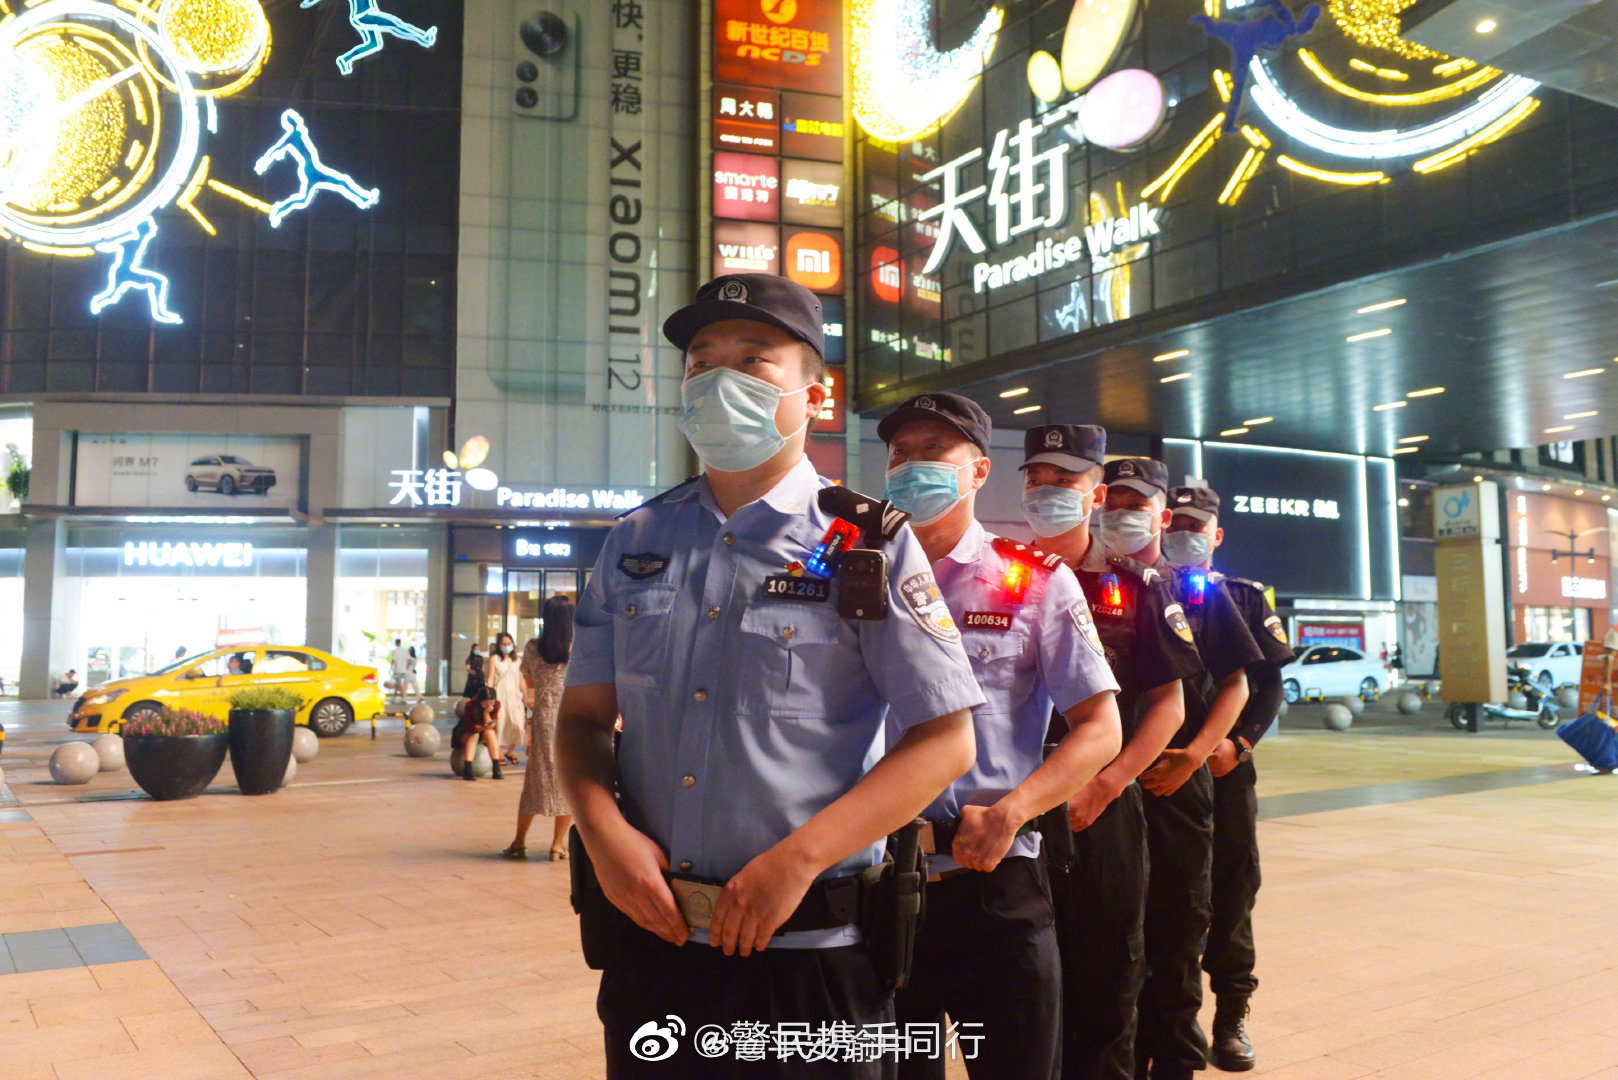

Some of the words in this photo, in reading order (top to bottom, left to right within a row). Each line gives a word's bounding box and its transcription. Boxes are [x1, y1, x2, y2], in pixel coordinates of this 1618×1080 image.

[726, 19, 831, 54] 新世纪百货
[715, 171, 778, 189] smarte
[917, 110, 1069, 275] 天街
[974, 237, 1082, 294] Paradise
[1085, 202, 1161, 257] Walk
[608, 354, 641, 391] 12
[388, 468, 462, 506] 天街
[497, 487, 590, 509] Paradise
[592, 489, 645, 510] Walk
[1234, 495, 1310, 517] ZEEKR
[124, 541, 253, 567] HUAWEI
[767, 579, 825, 598] 101261
[967, 614, 1009, 627] 100634
